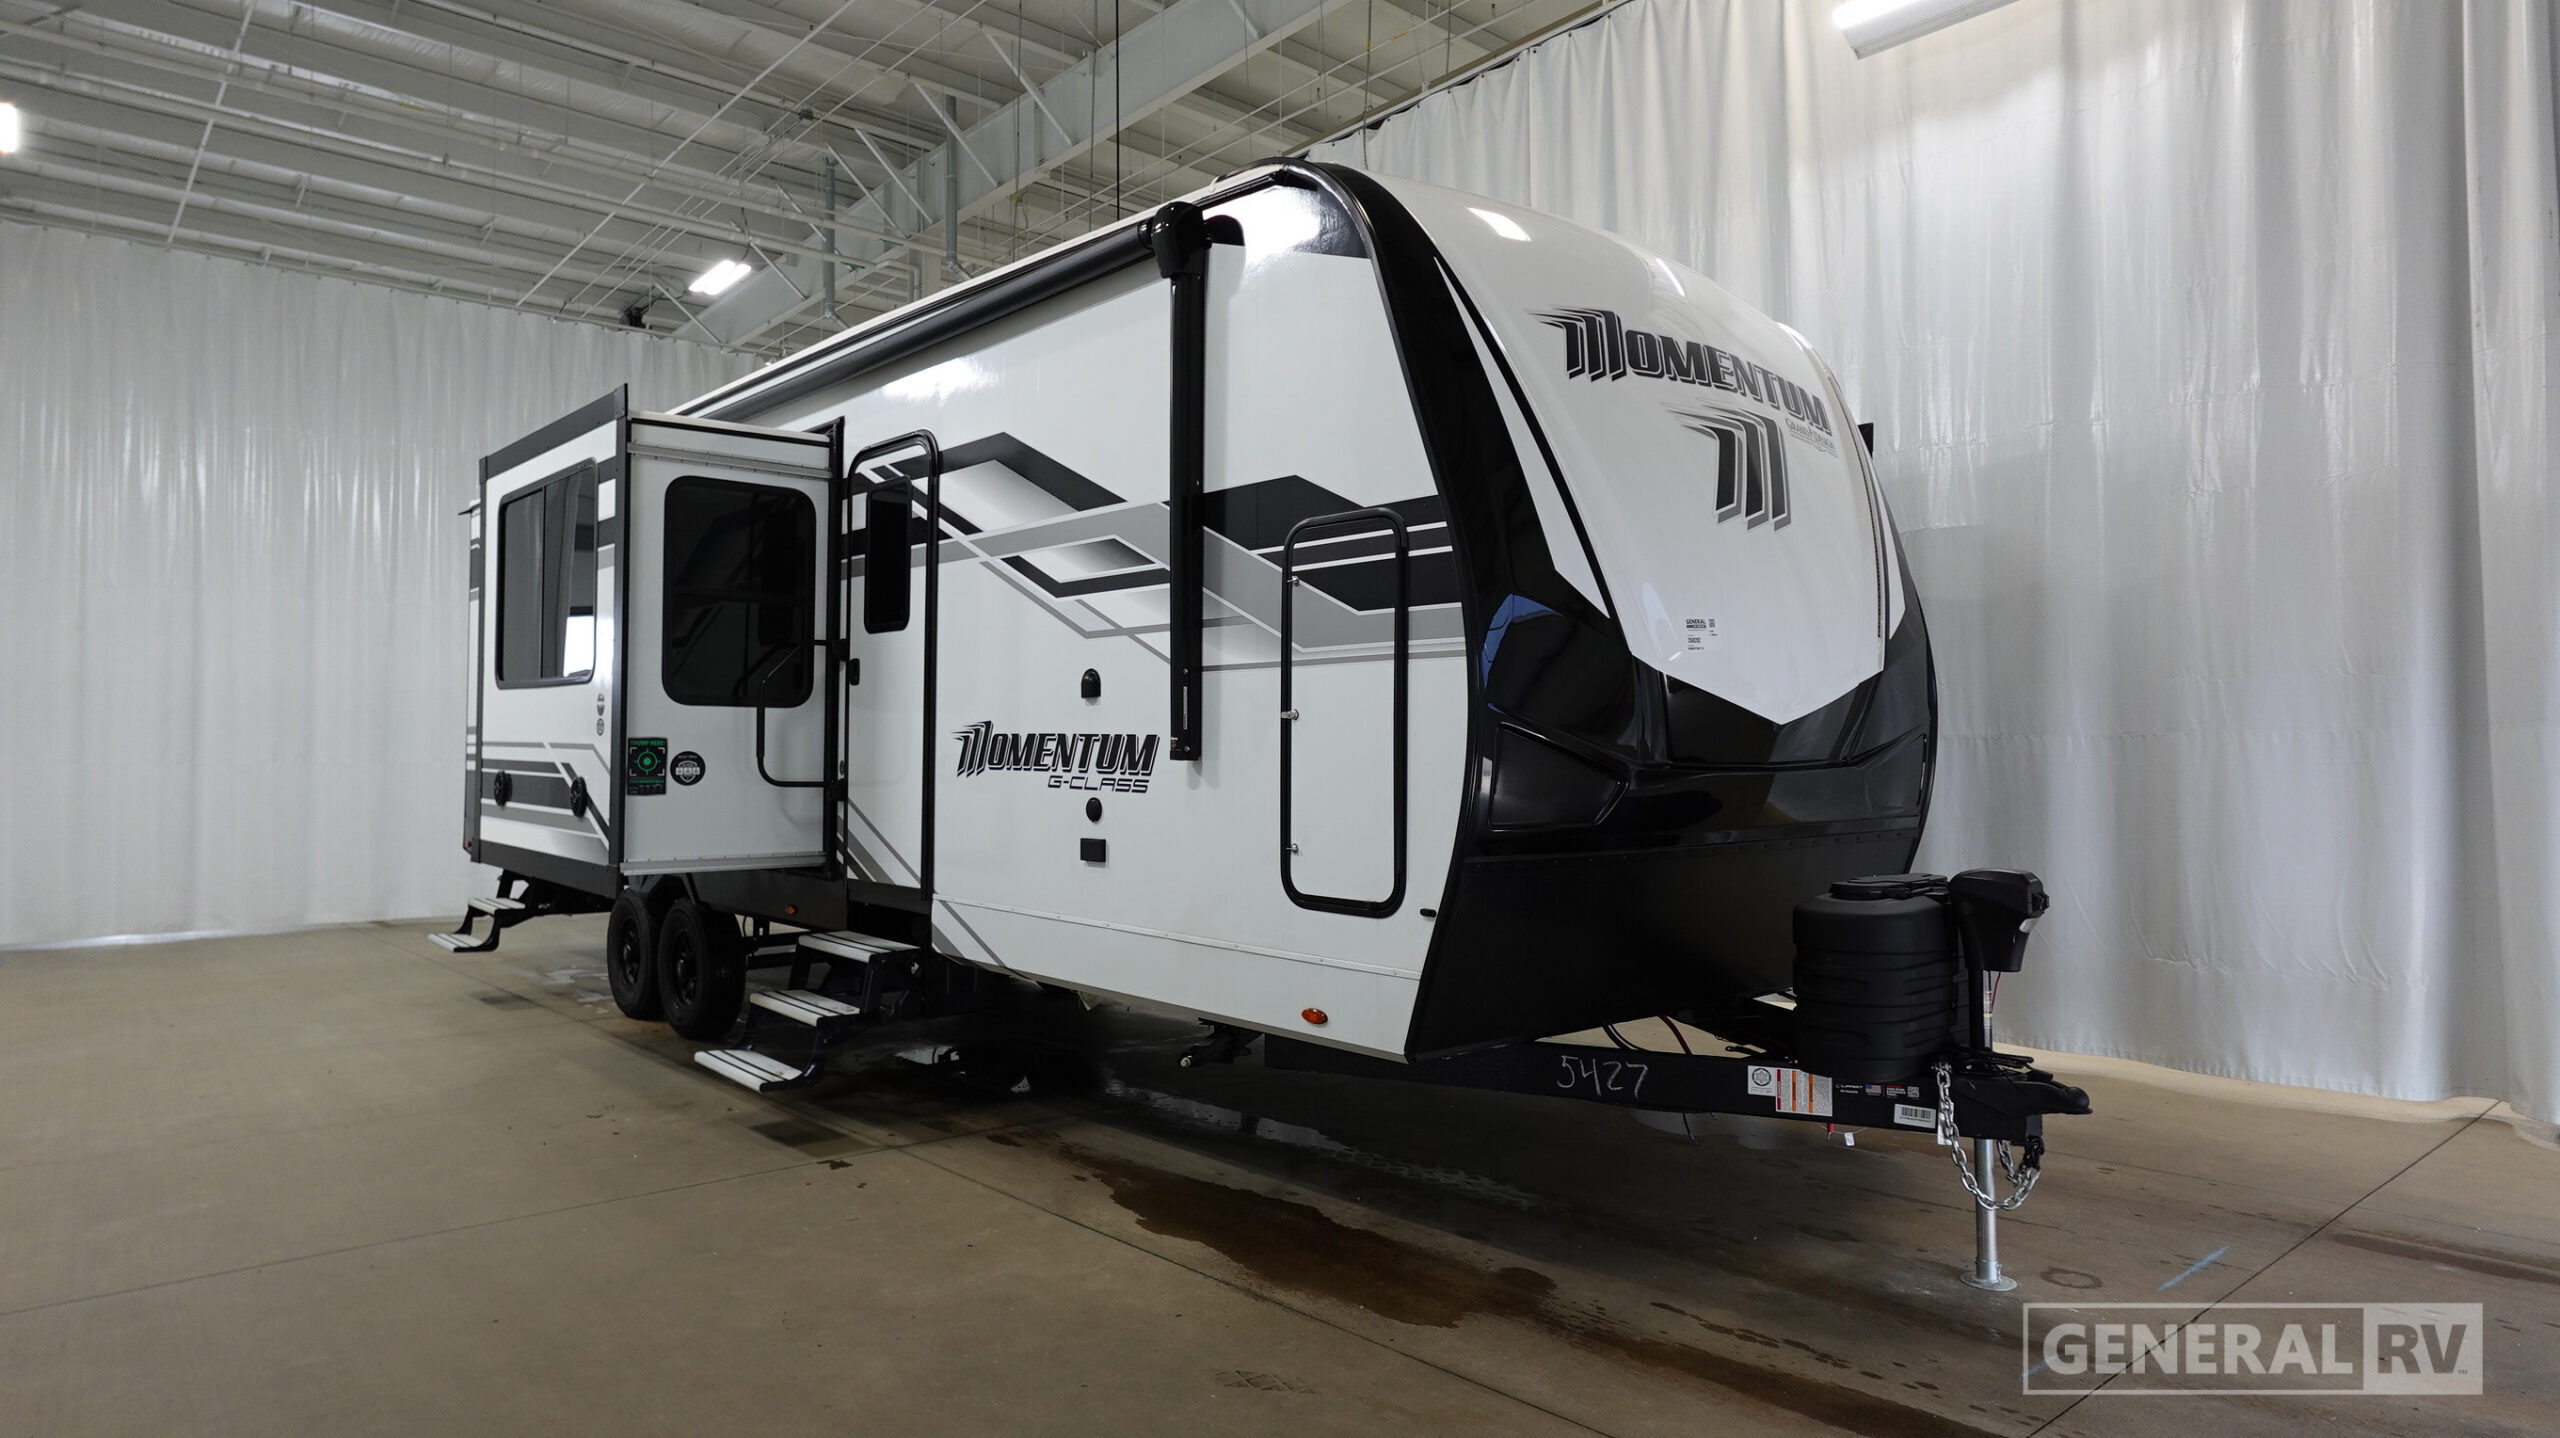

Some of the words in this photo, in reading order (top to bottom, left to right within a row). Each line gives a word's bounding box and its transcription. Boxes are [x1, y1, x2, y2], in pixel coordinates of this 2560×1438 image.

[1528, 307, 1832, 436] MOMENTUM
[952, 720, 1160, 777] MOMENTUM
[1048, 775, 1150, 793] G-CLASS
[1557, 1055, 1648, 1098] 5427
